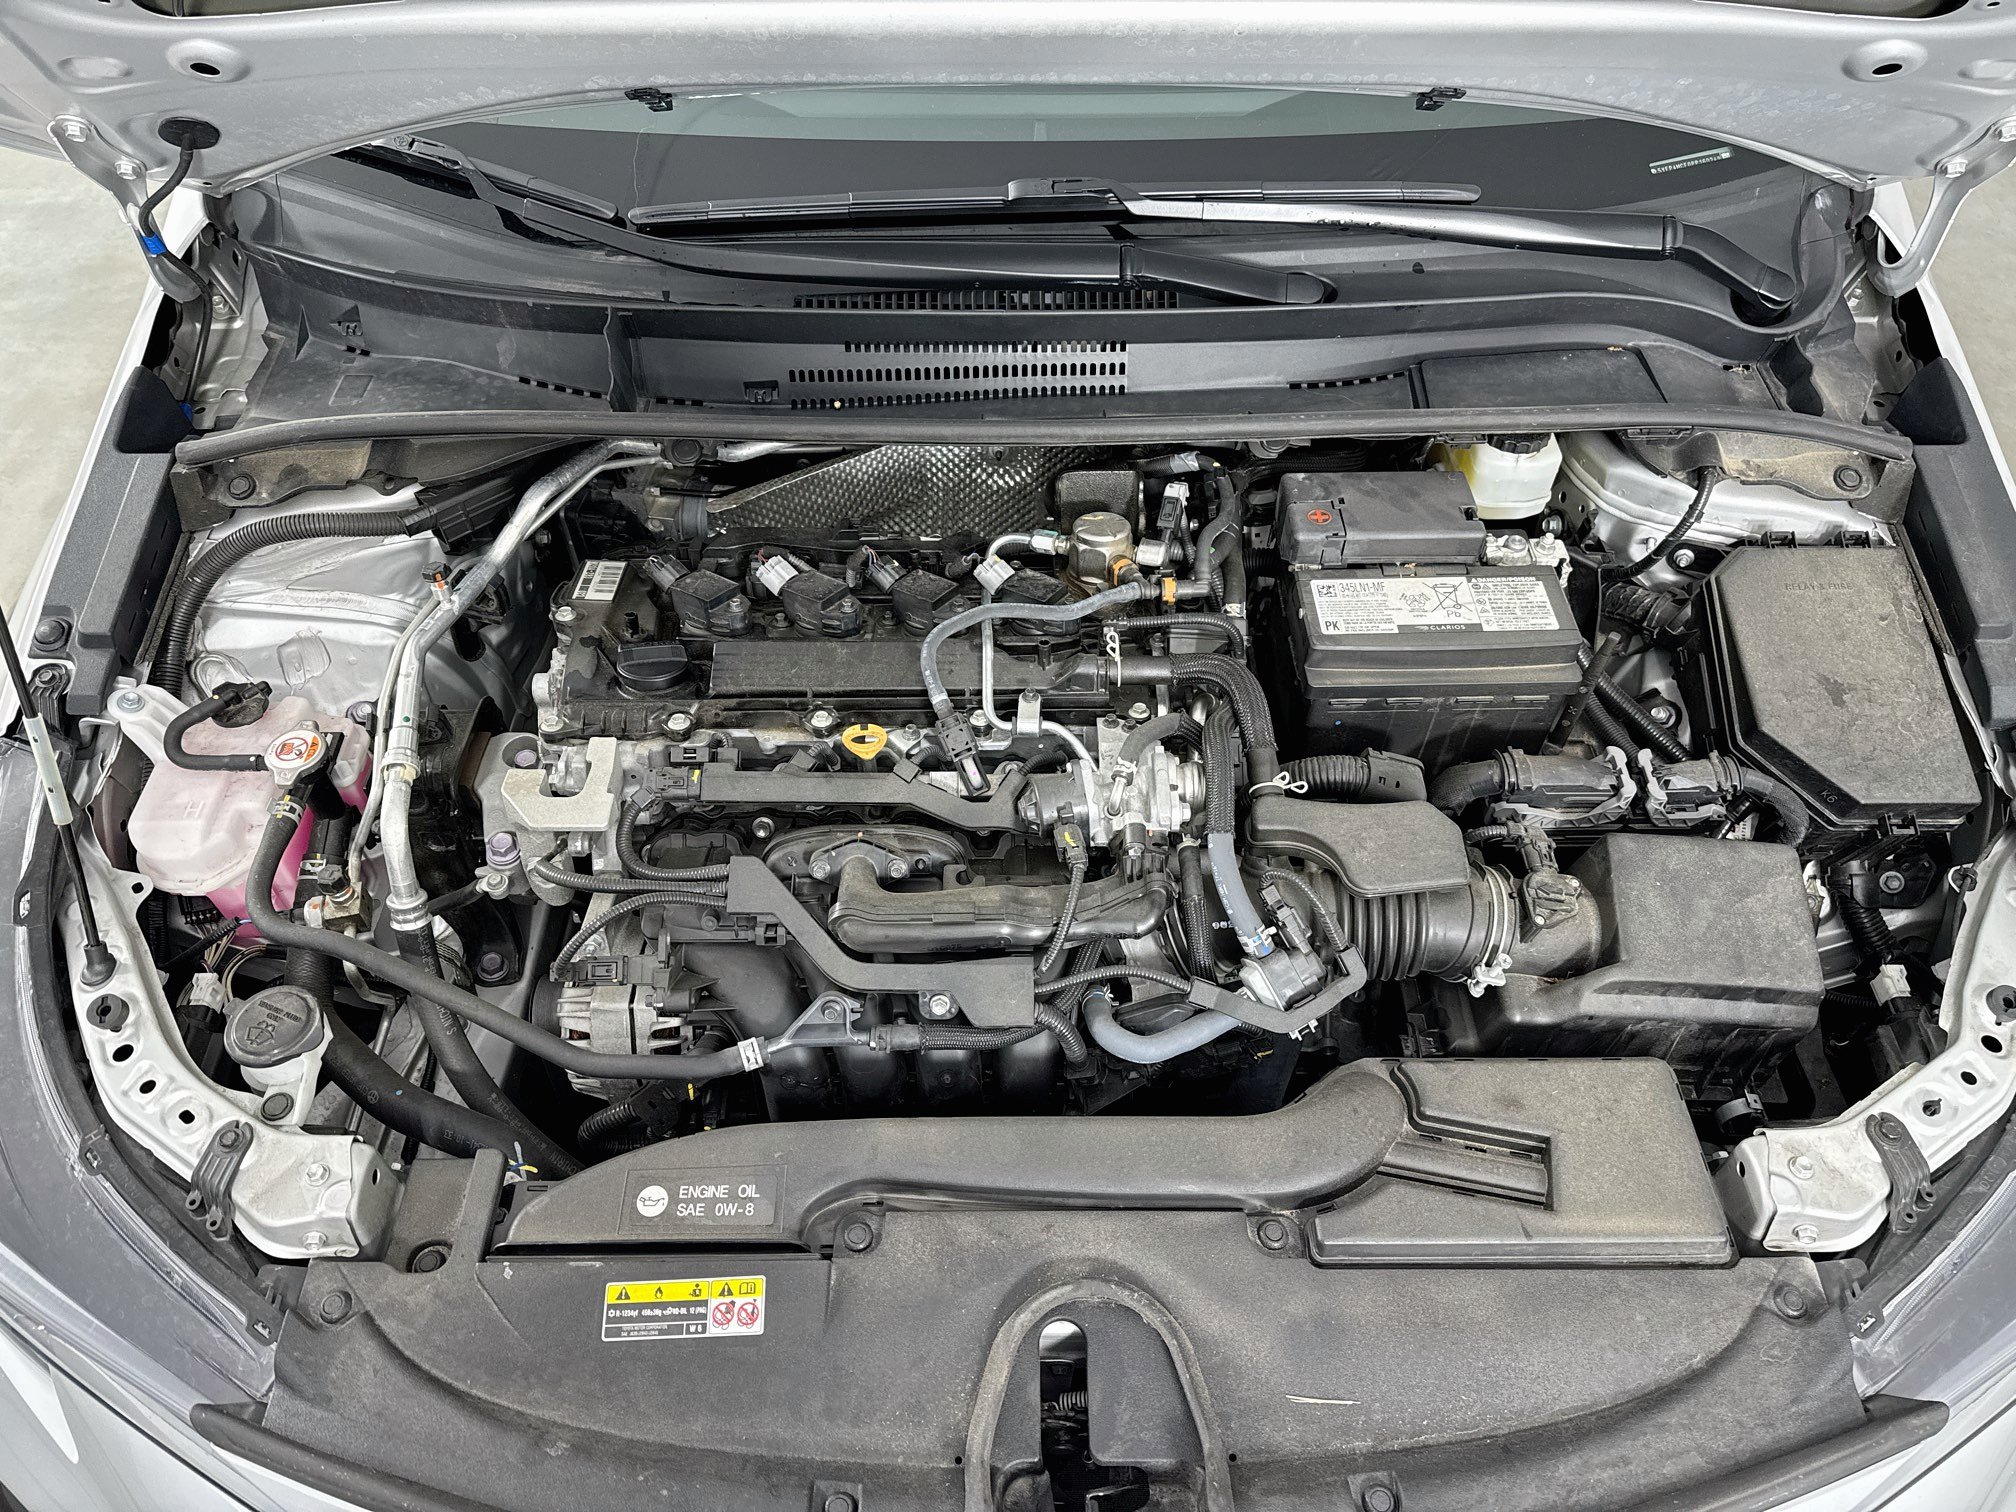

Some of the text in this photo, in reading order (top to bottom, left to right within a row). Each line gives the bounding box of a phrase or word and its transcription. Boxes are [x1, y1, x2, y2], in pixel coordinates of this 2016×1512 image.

[1339, 582, 1386, 593] 345LN1-MF
[1325, 620, 1340, 631] PK
[678, 1184, 760, 1199] ENGINE OIL
[676, 1202, 755, 1216] SAE 0W-8
[616, 1309, 639, 1317] R-1234yf
